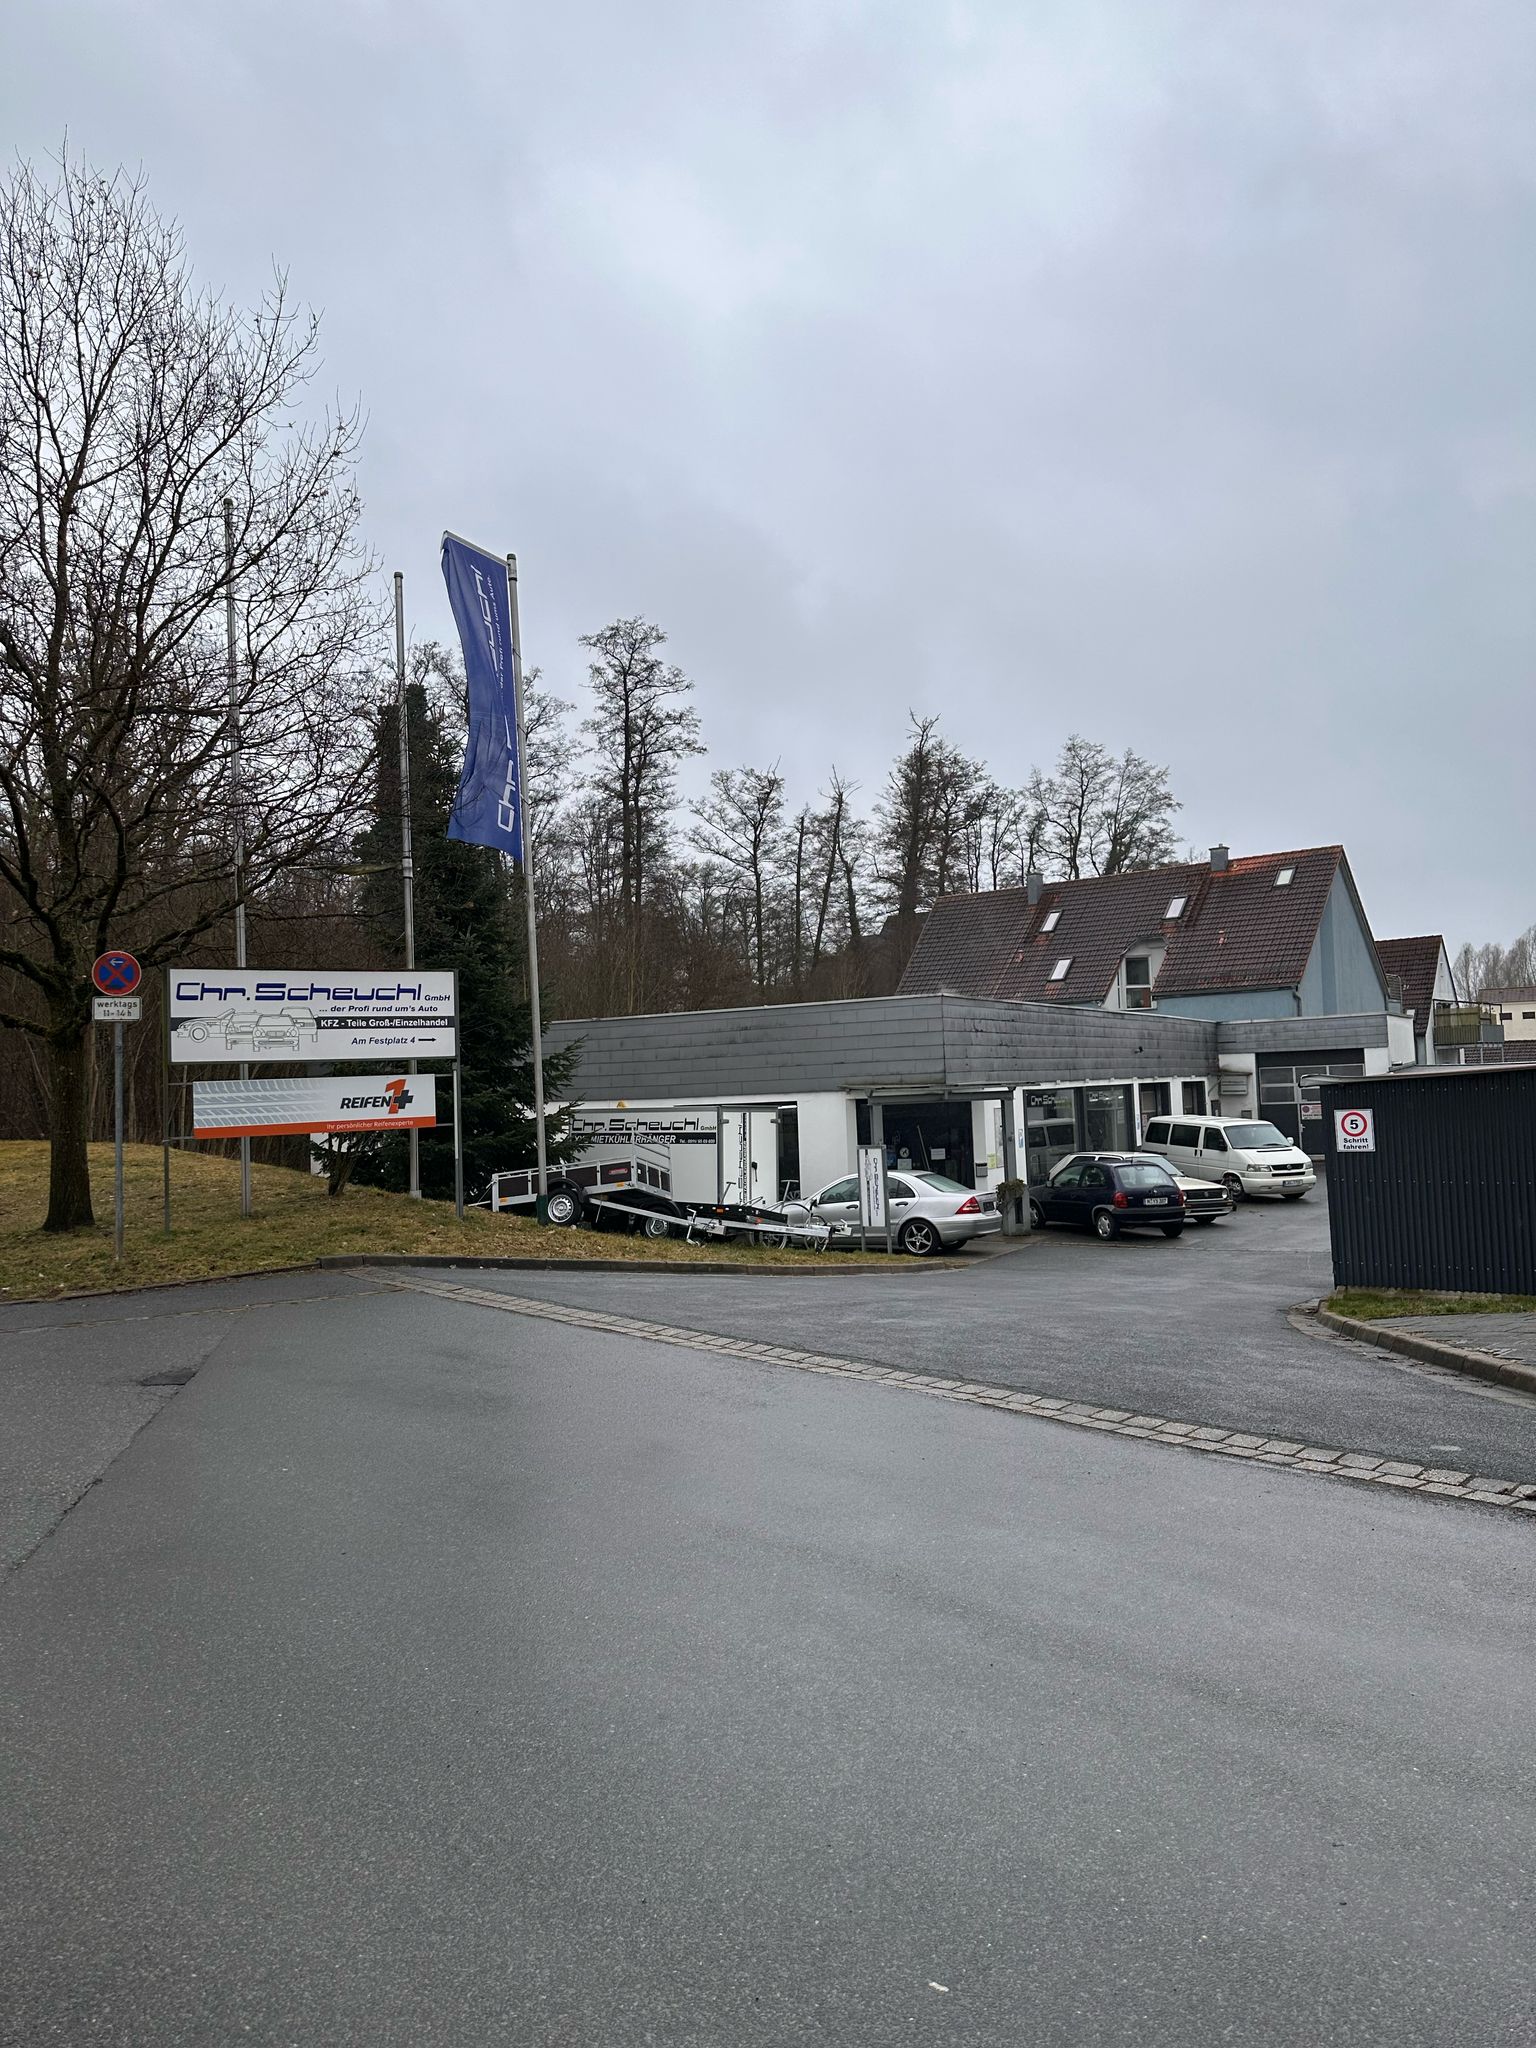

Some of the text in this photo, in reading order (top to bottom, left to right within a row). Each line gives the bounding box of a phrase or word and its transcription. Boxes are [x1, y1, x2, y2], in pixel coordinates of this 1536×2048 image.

[255, 982, 422, 1001] Scheuchl
[424, 994, 451, 1002] GmbH
[97, 1000, 138, 1009] werktags
[321, 1019, 339, 1027] KFZ
[346, 1019, 367, 1027] Teile
[351, 1037, 367, 1045] Am
[369, 1036, 408, 1046] Festplatz
[336, 1122, 373, 1131] persönlicher
[373, 1120, 414, 1128] Reifenexperte
[608, 1117, 700, 1131] Scheuchl
[1349, 1119, 1359, 1130] 5
[590, 1133, 676, 1144] MIETKÜHLRHÄNGER
